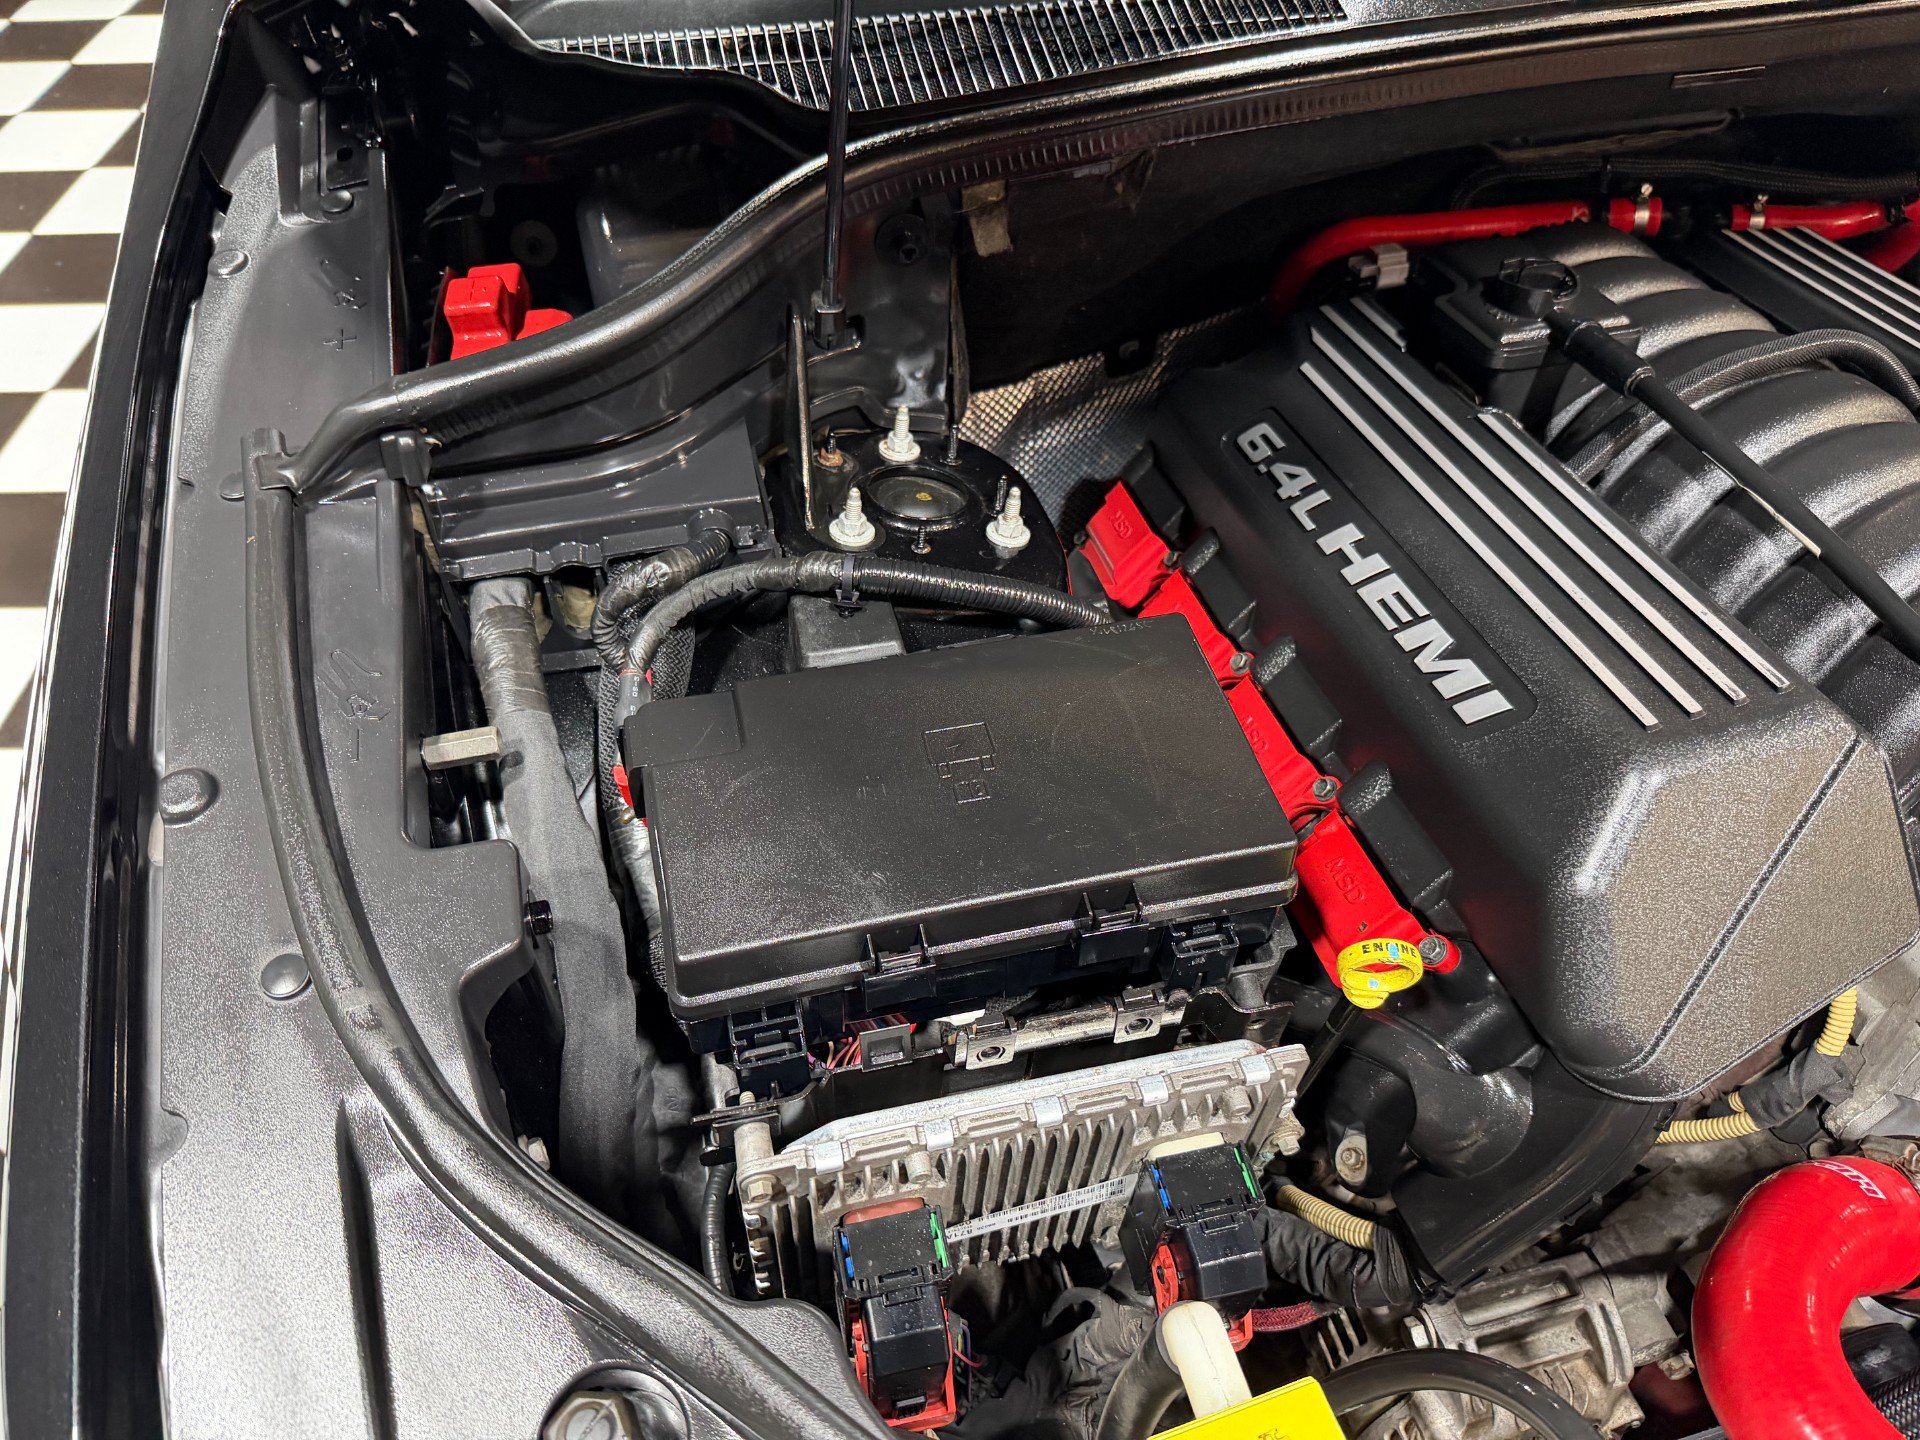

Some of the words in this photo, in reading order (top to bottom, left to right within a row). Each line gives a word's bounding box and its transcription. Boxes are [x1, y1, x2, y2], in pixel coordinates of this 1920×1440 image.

[1236, 422, 1332, 532] 6.4L
[1316, 522, 1515, 726] HEMI
[1325, 856, 1365, 904] MSD
